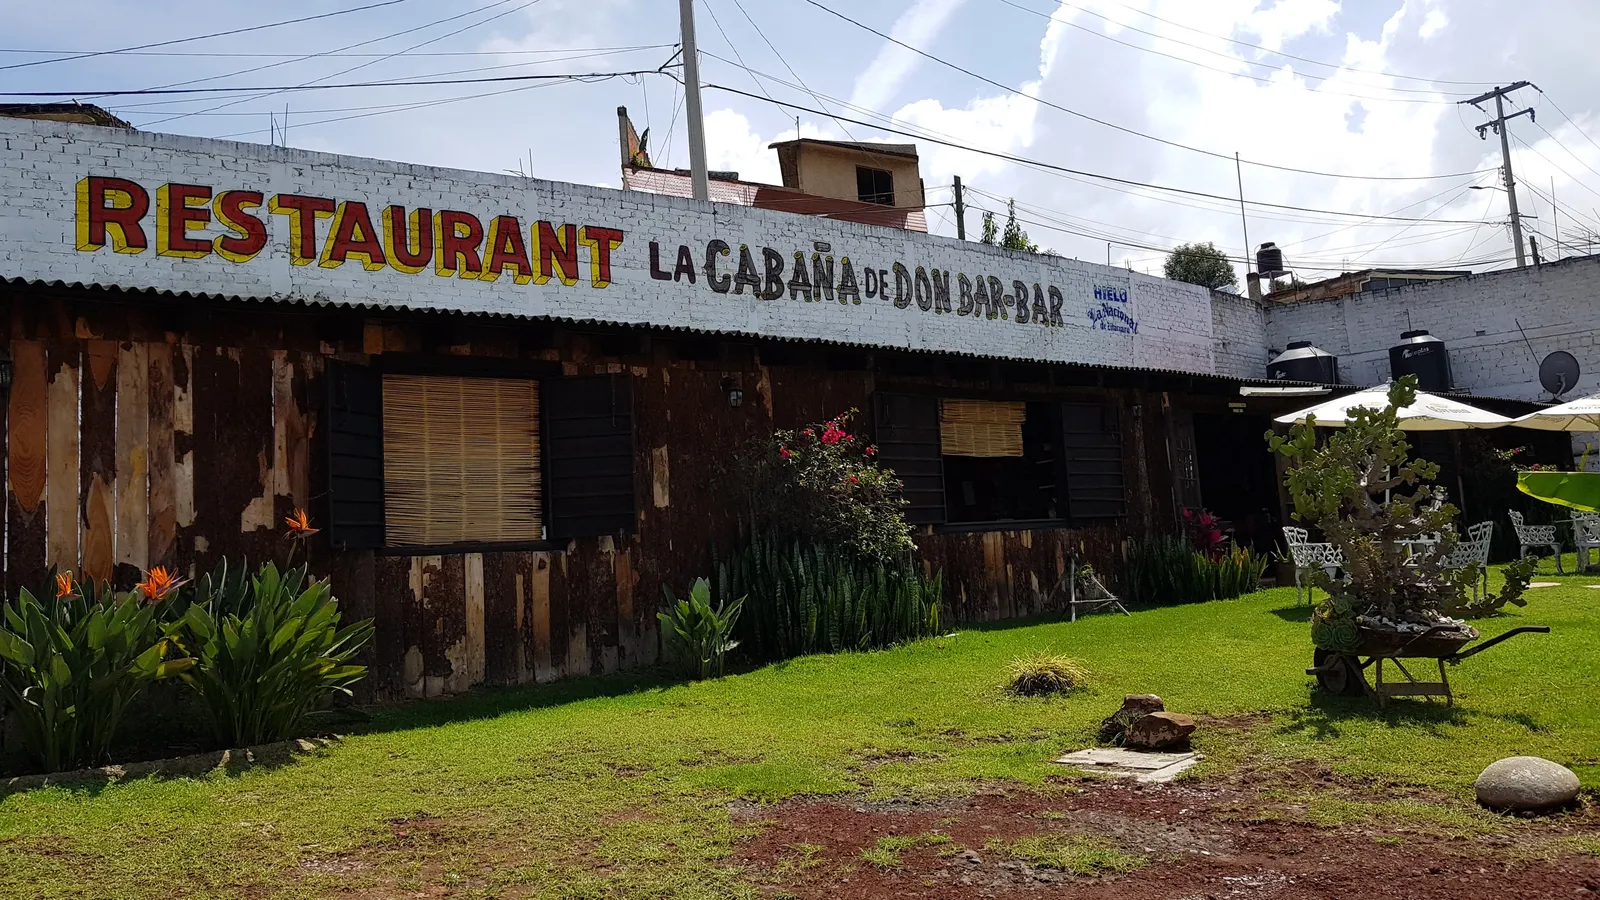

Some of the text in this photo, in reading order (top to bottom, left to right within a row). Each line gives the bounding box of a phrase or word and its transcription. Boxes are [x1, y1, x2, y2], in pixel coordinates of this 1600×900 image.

[75, 175, 624, 289] RESTAURANT
[649, 239, 1064, 327] LA CABAÑA DE DON BAR-BAR
[1094, 285, 1127, 302] HIELO
